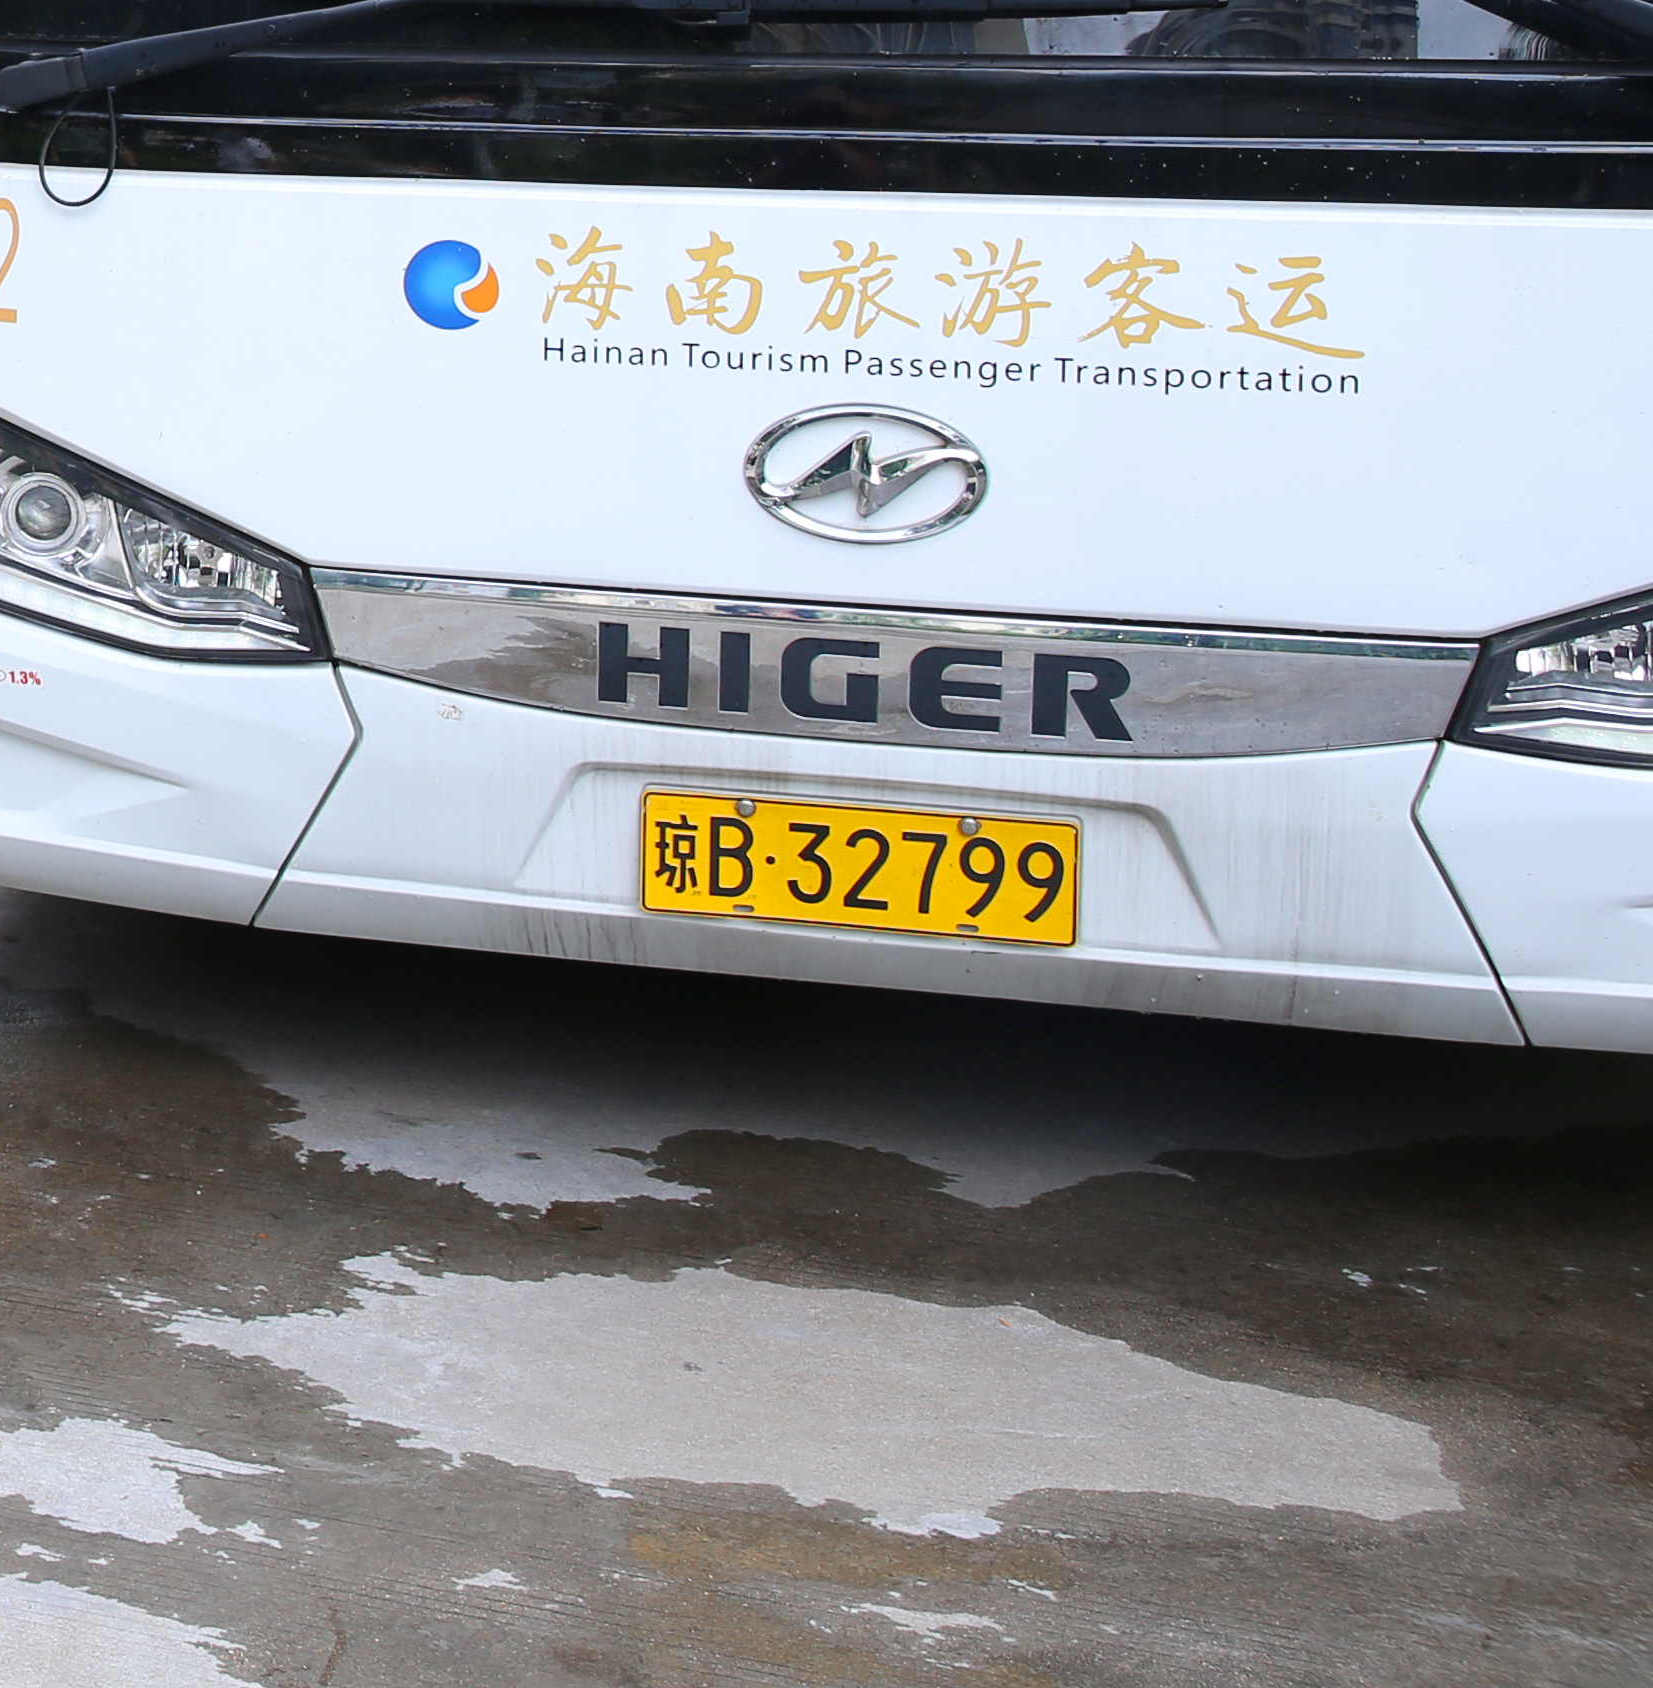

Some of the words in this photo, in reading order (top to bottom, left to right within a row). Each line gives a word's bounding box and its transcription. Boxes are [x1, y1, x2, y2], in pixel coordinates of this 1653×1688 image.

[534, 225, 1365, 359] 海南旅游客运
[542, 336, 669, 367] Hainan
[682, 342, 829, 374] Tourism
[844, 349, 1041, 389] Passenger
[1054, 357, 1361, 396] Transportation
[9, 670, 41, 686] 1.3%
[598, 620, 1134, 742] HIGER
[654, 814, 1065, 923] 琼B·32799
